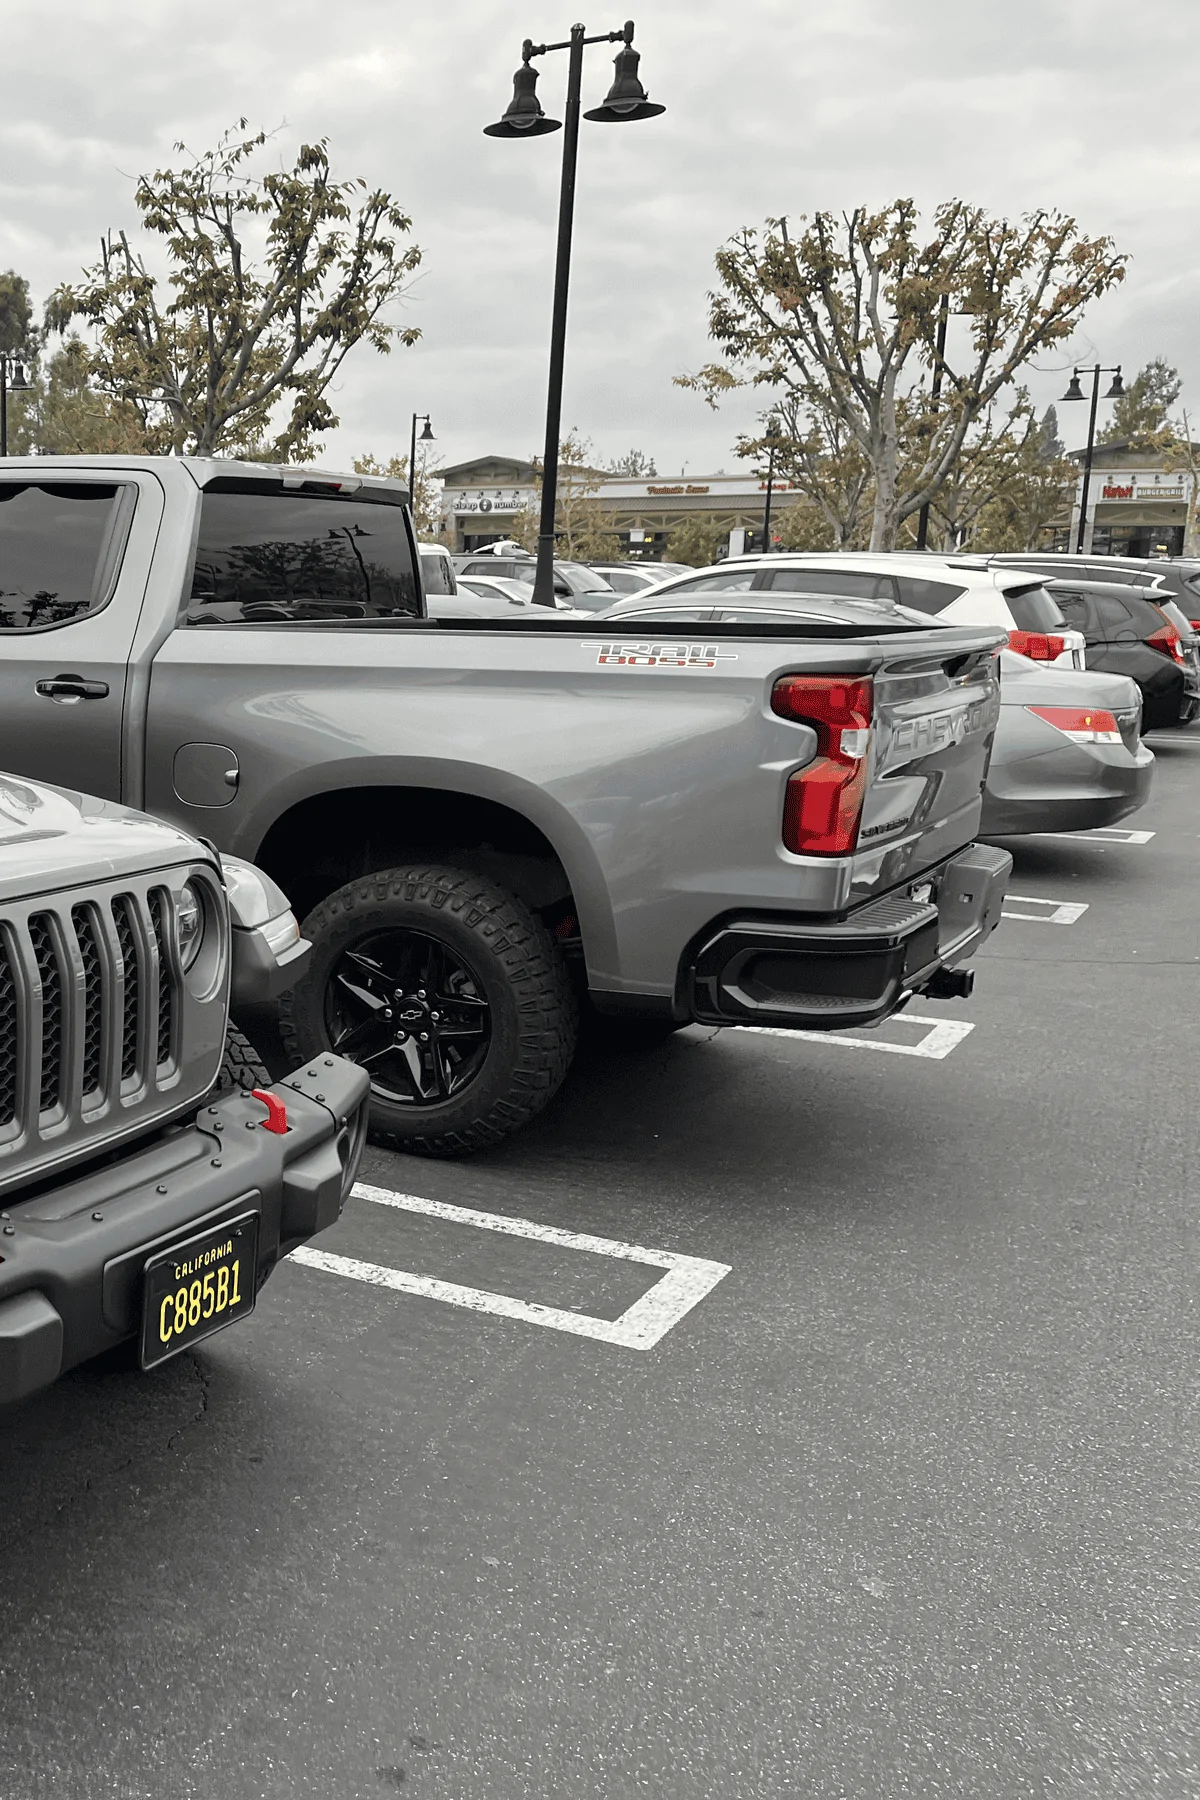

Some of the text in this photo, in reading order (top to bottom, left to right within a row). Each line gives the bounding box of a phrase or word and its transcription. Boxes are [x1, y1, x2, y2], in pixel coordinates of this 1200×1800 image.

[759, 481, 787, 491] Jesey
[1137, 488, 1165, 496] BURGER
[453, 499, 527, 511] sleep number
[581, 642, 738, 660] TRAIL
[597, 655, 716, 668] BOSS
[892, 704, 998, 752] CHEVRO
[175, 1240, 232, 1280] CALIFORNIA
[160, 1260, 241, 1342] C885B1
